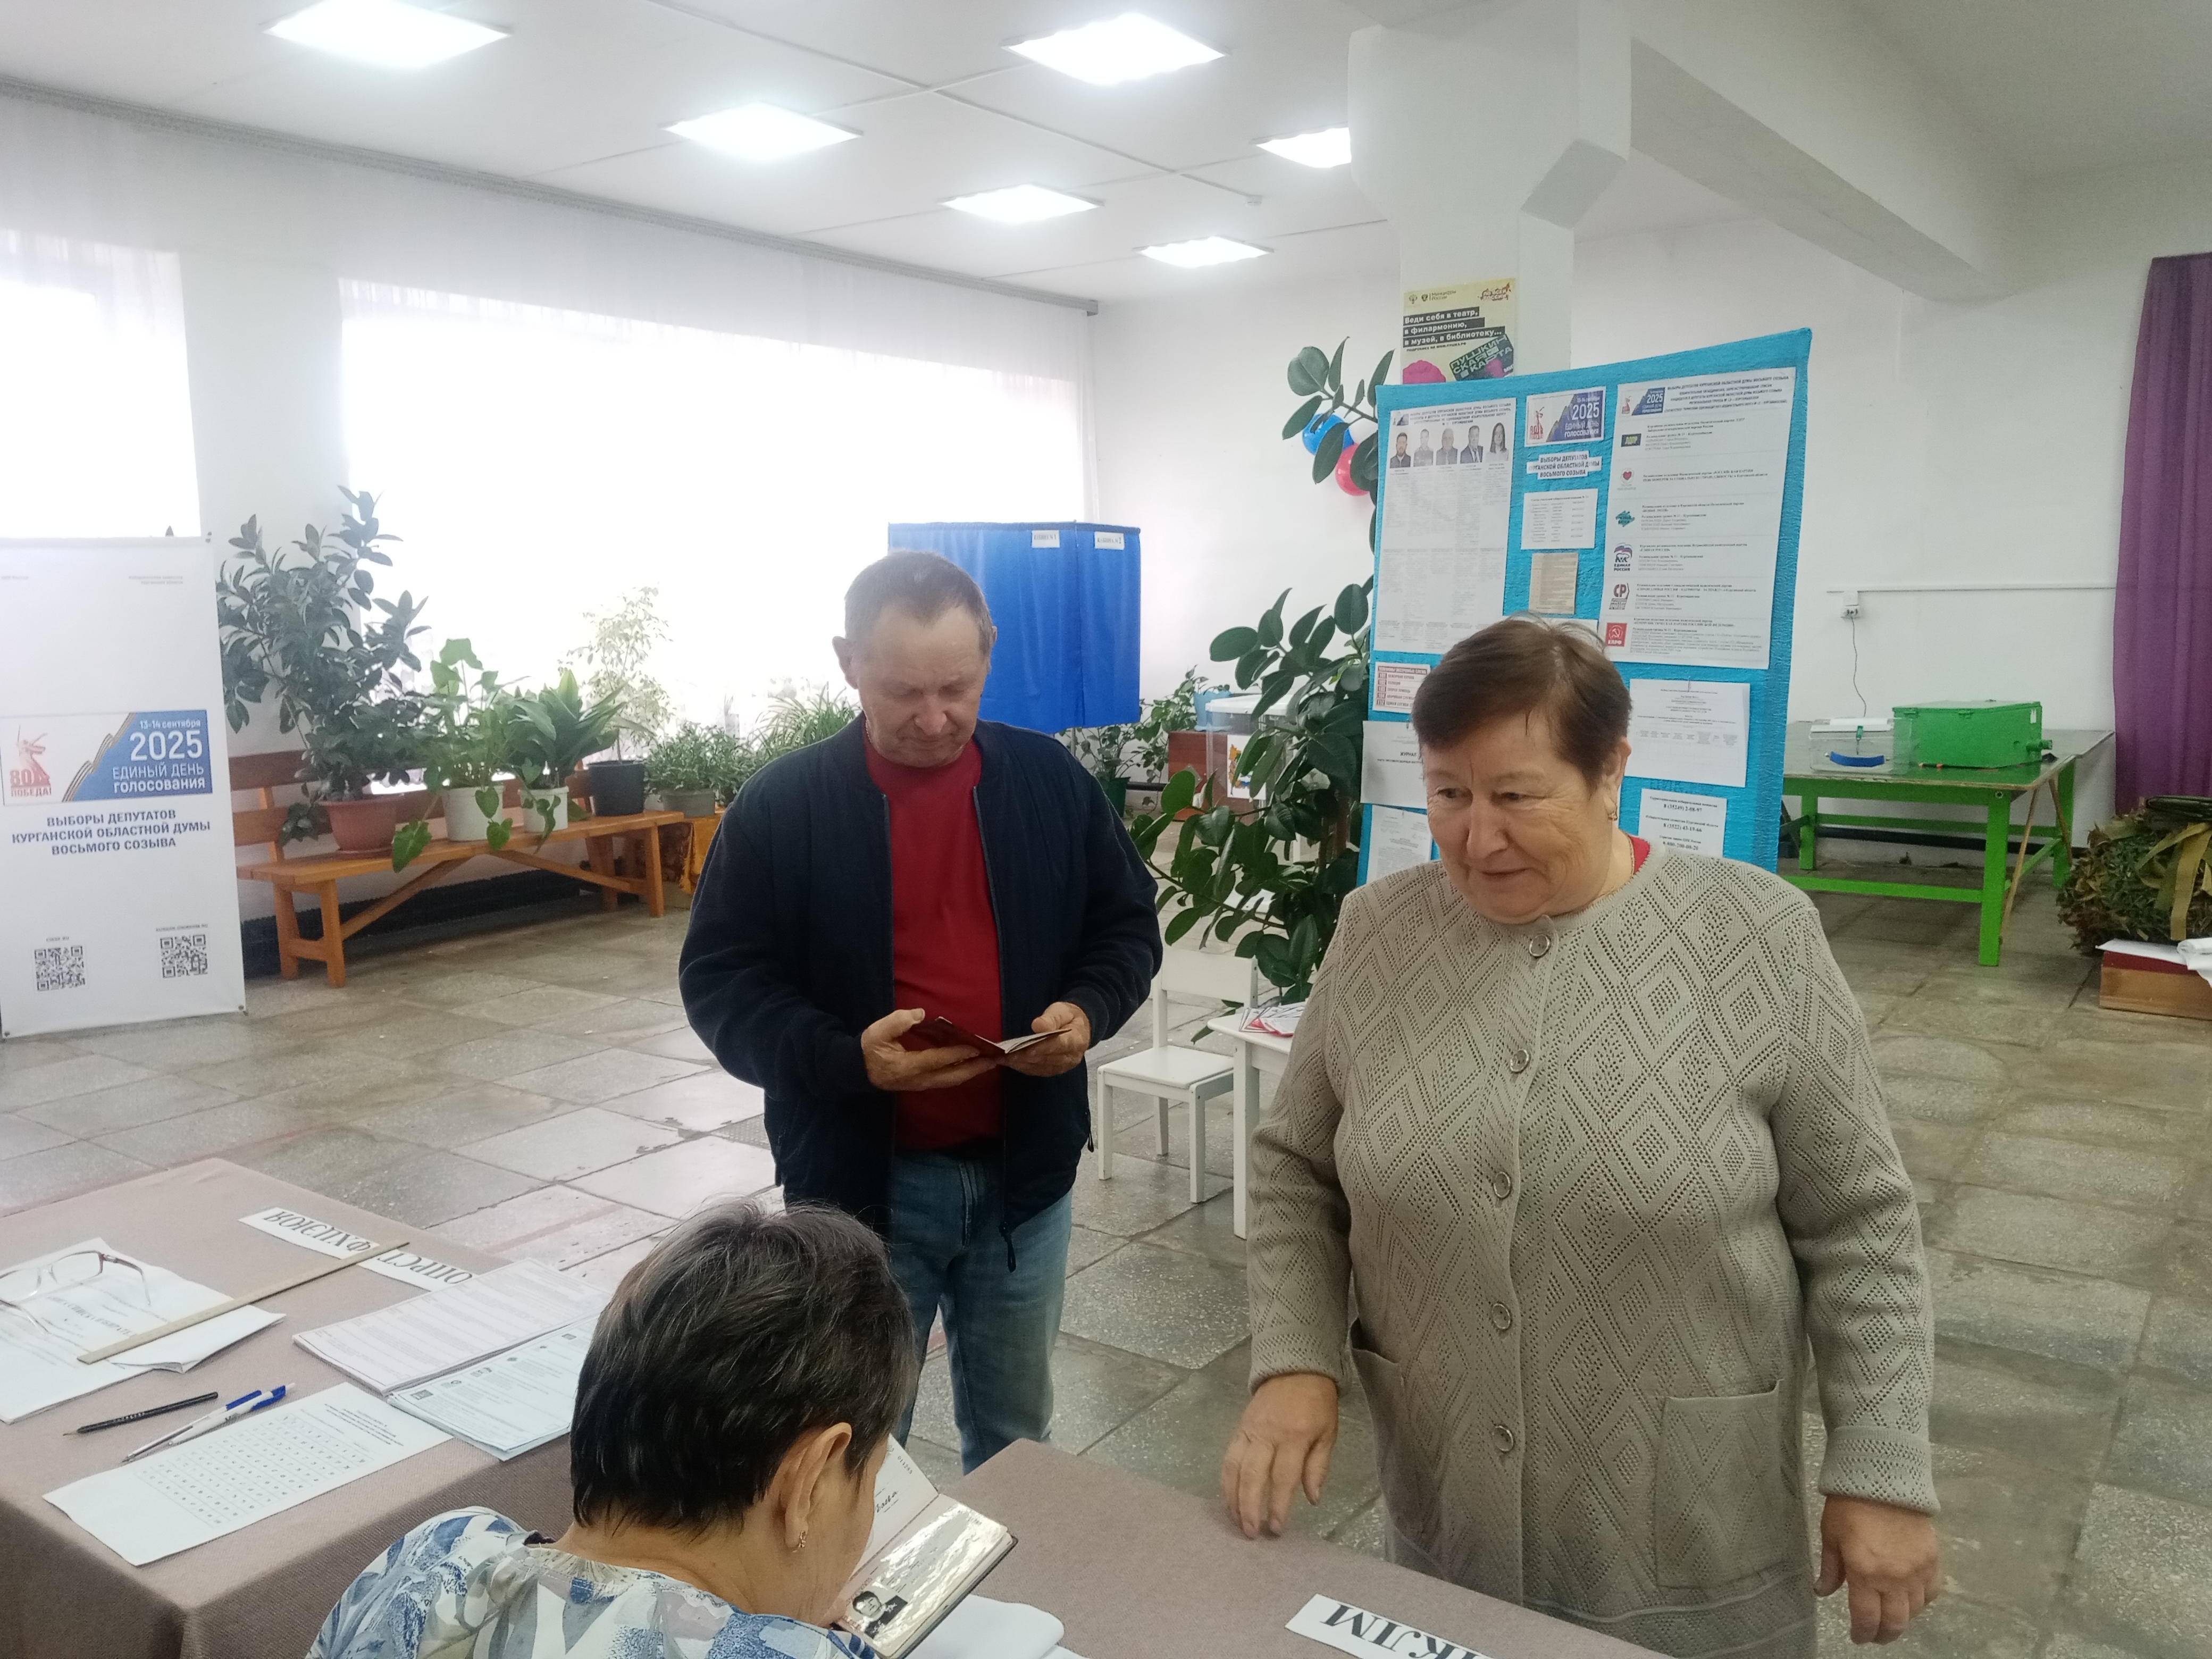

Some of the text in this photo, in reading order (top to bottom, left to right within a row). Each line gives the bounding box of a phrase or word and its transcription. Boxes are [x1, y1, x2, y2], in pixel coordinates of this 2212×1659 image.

[1405, 316, 1424, 324] Веди
[1426, 313, 1445, 322] себя
[1454, 309, 1478, 318] театр,
[1411, 322, 1468, 334] филармонию,
[1411, 335, 1438, 346] музей,
[1647, 394, 1663, 404] 2025
[1571, 402, 1600, 421] 2025
[1557, 461, 1585, 470] ОБЛАСТНОЙ
[1562, 454, 1588, 463] ДЕПУТАТОВ
[1613, 584, 1627, 598] СР
[139, 718, 202, 731] 13-14 сентября
[129, 730, 203, 762] 2025
[112, 761, 204, 780] ЕДИНЫЙ ДЕНЬ
[47, 809, 176, 827] ВЫБОРЫ ДЕПУТАТОВ
[12, 821, 211, 844] КУРГАНСКОЙ ОБЛАСТНОЙ ДУМЫ
[52, 837, 176, 856] ВОСЬМОГО СОЗЫВА
